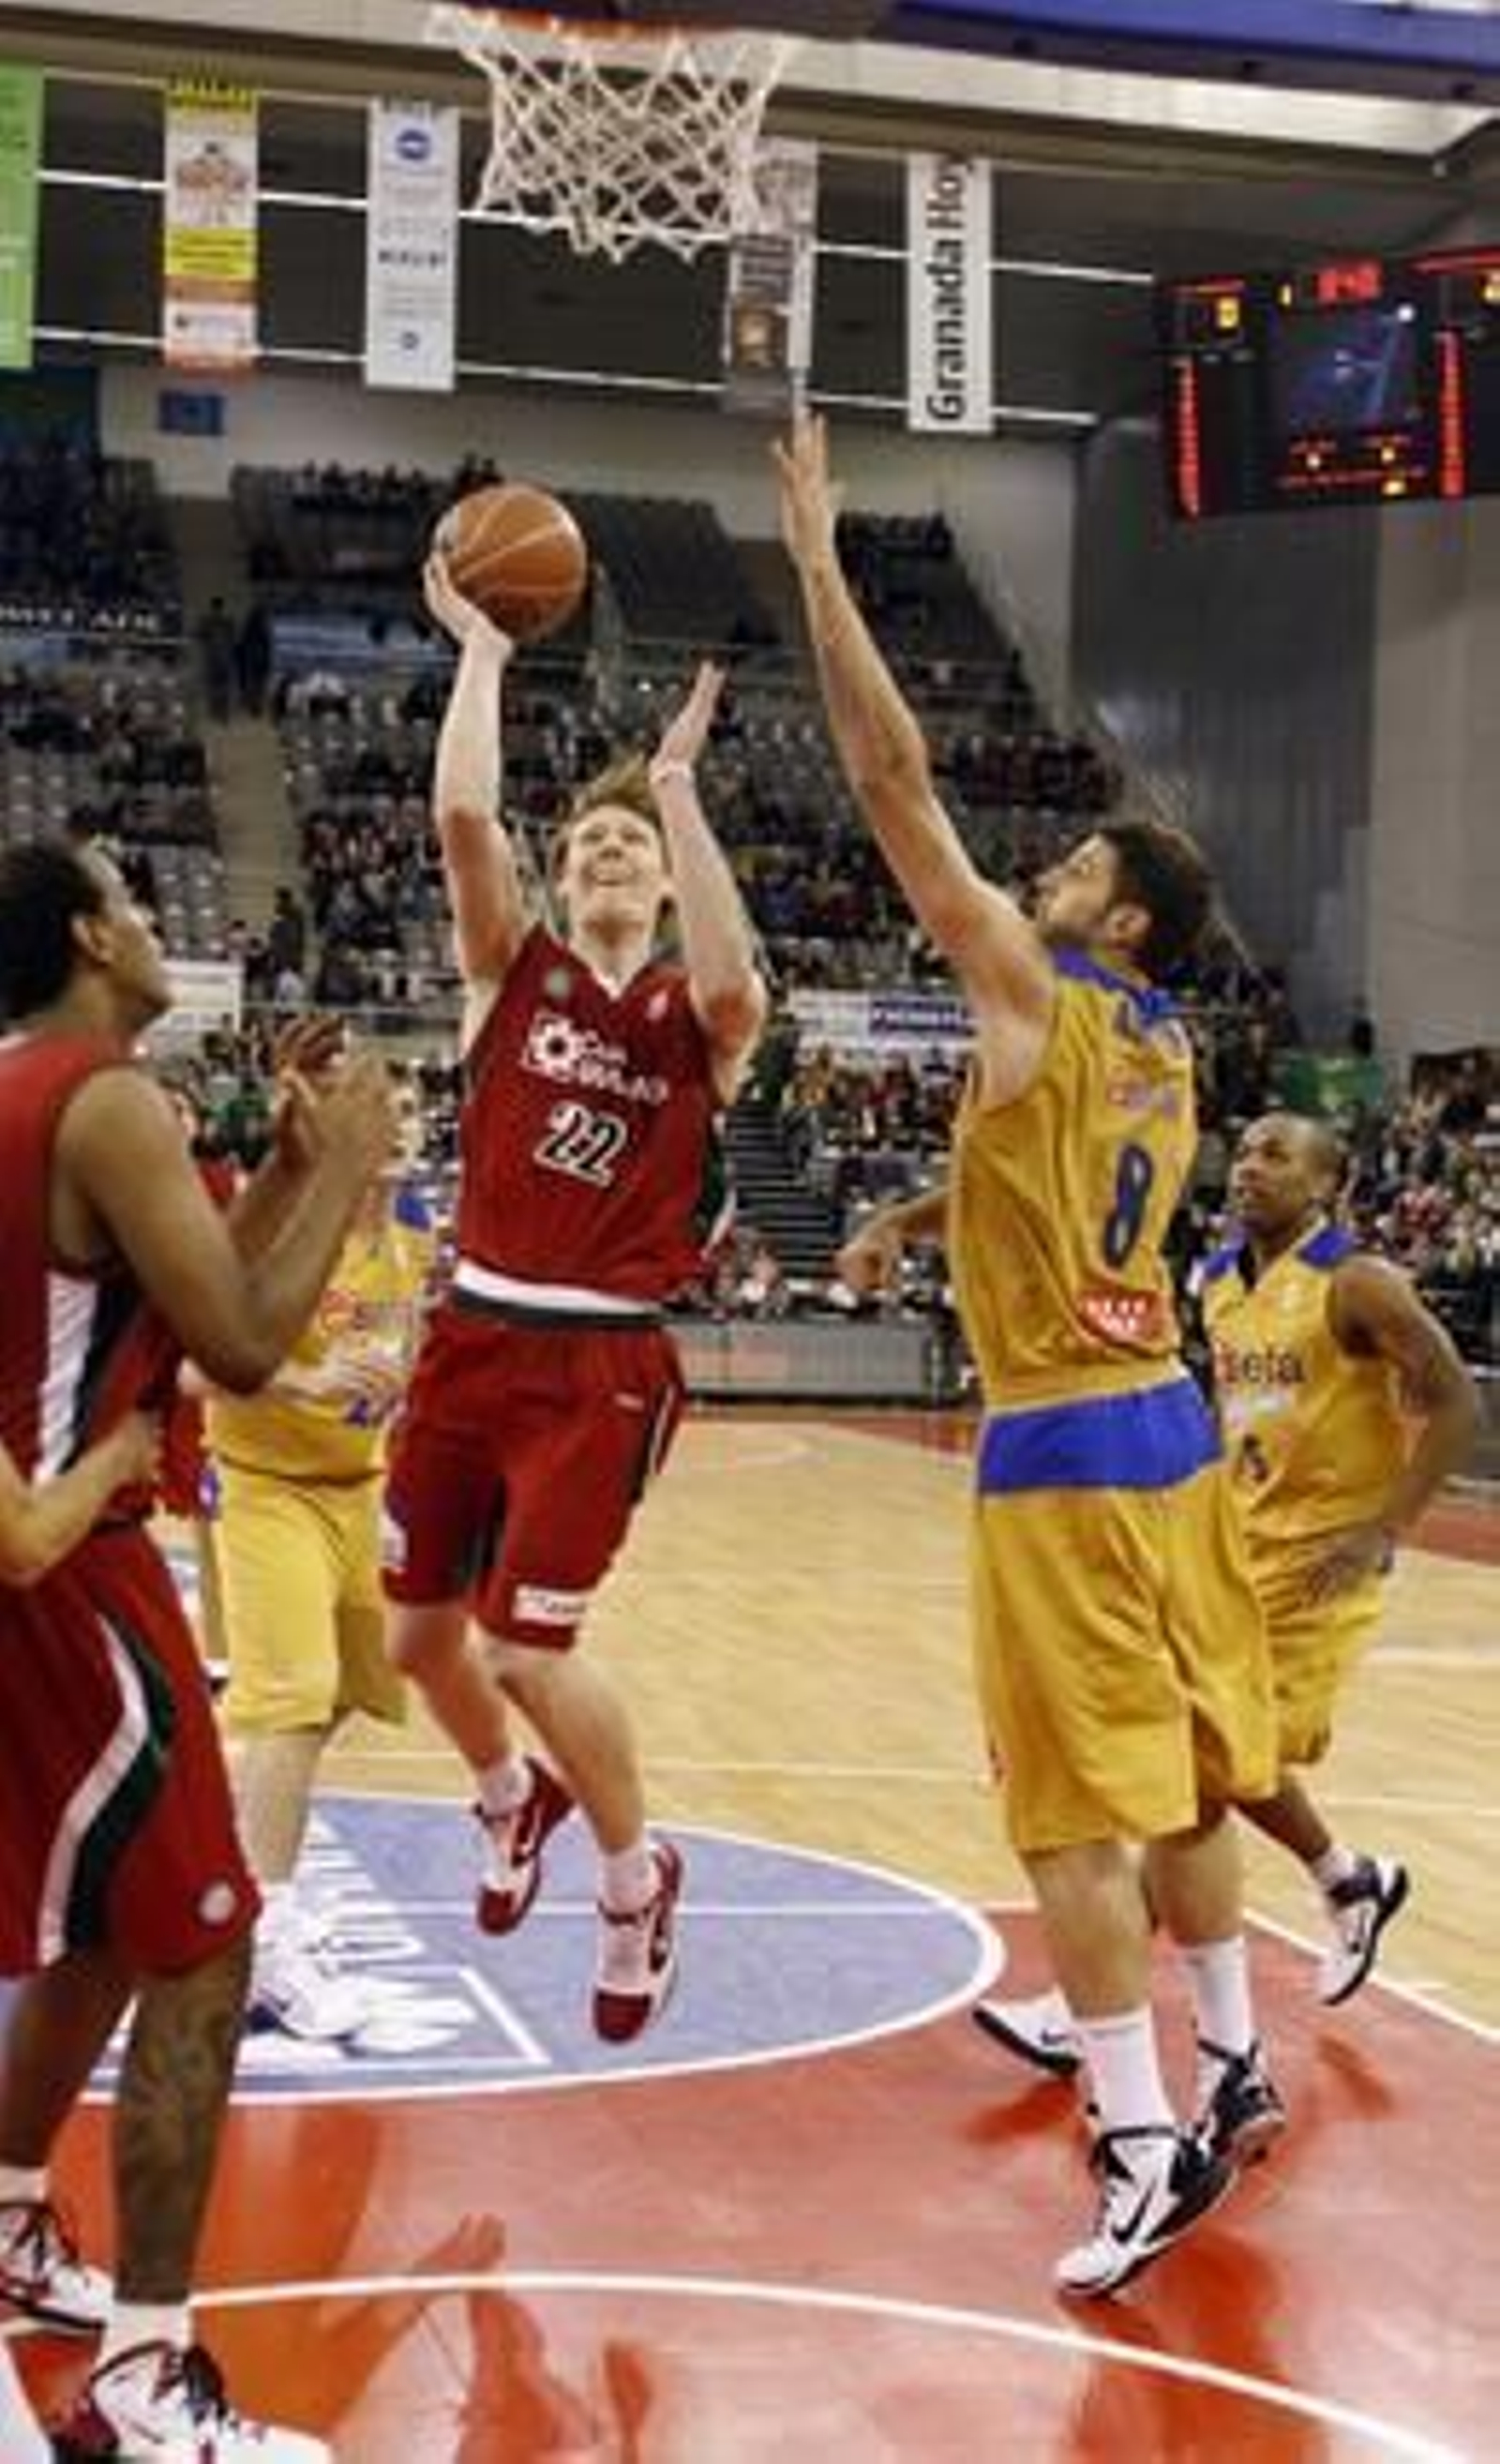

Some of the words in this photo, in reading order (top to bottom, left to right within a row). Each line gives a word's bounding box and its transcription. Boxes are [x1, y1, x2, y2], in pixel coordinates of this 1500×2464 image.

[925, 238, 968, 420] Granada
[532, 1100, 628, 1188] 22
[1103, 1143, 1154, 1271] 8
